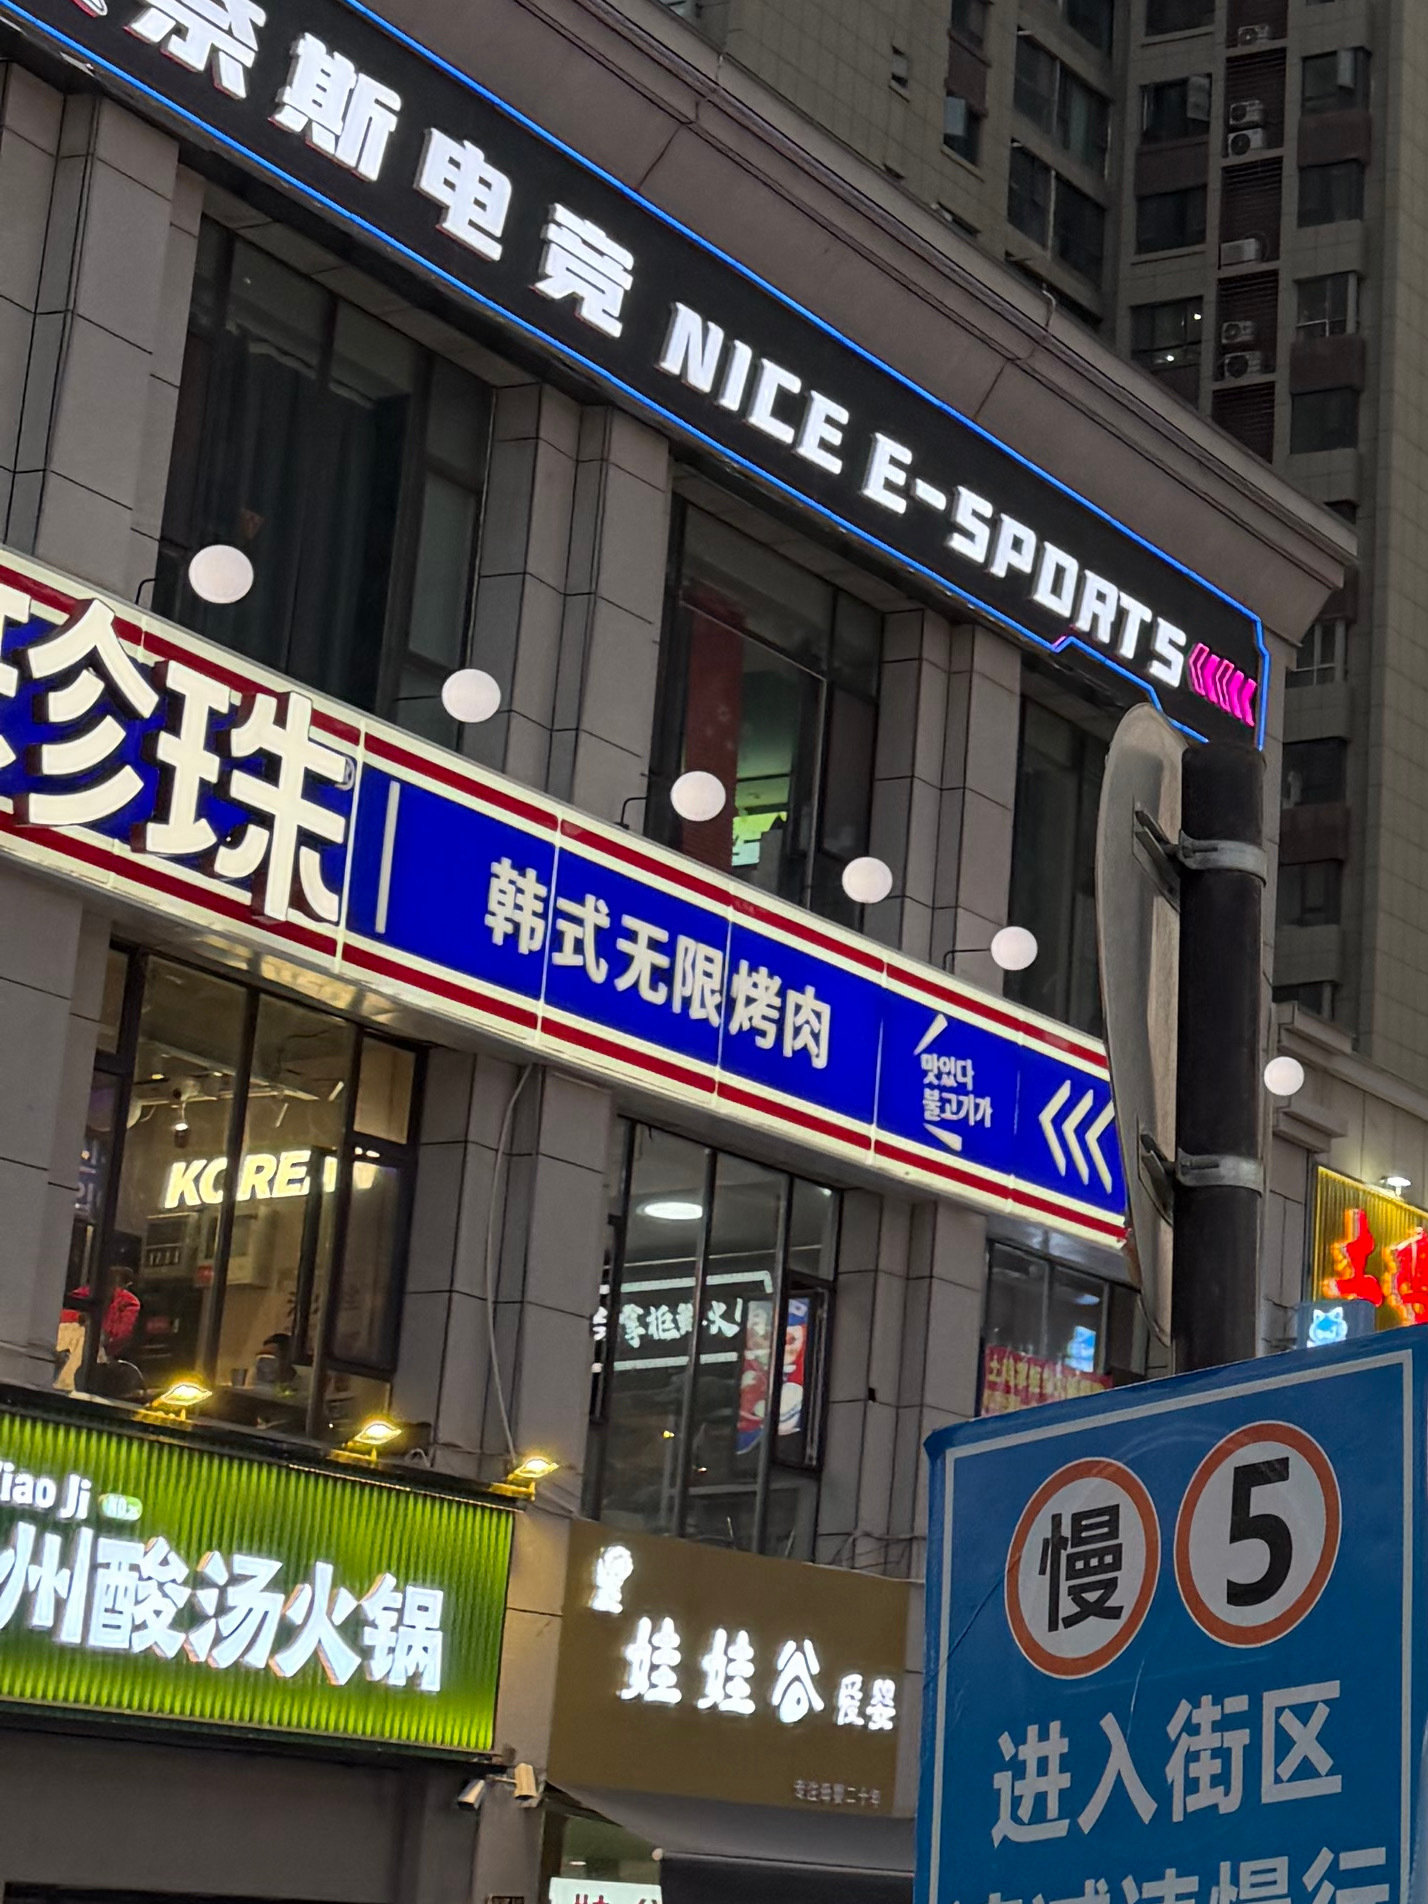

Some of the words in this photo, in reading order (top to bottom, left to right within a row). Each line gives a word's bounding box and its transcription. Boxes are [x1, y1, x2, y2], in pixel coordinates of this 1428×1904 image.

[656, 299, 850, 478] NICE
[861, 431, 1187, 690] E-SPORTS
[483, 856, 832, 1069] 韩式无限烤肉
[920, 1052, 975, 1089] 맛있다
[164, 1149, 338, 1210] KORE
[0, 1460, 57, 1509] iao
[1226, 1456, 1293, 1607] 5
[1038, 1503, 1124, 1633] 慢
[991, 1680, 1343, 1849] 进入街区
